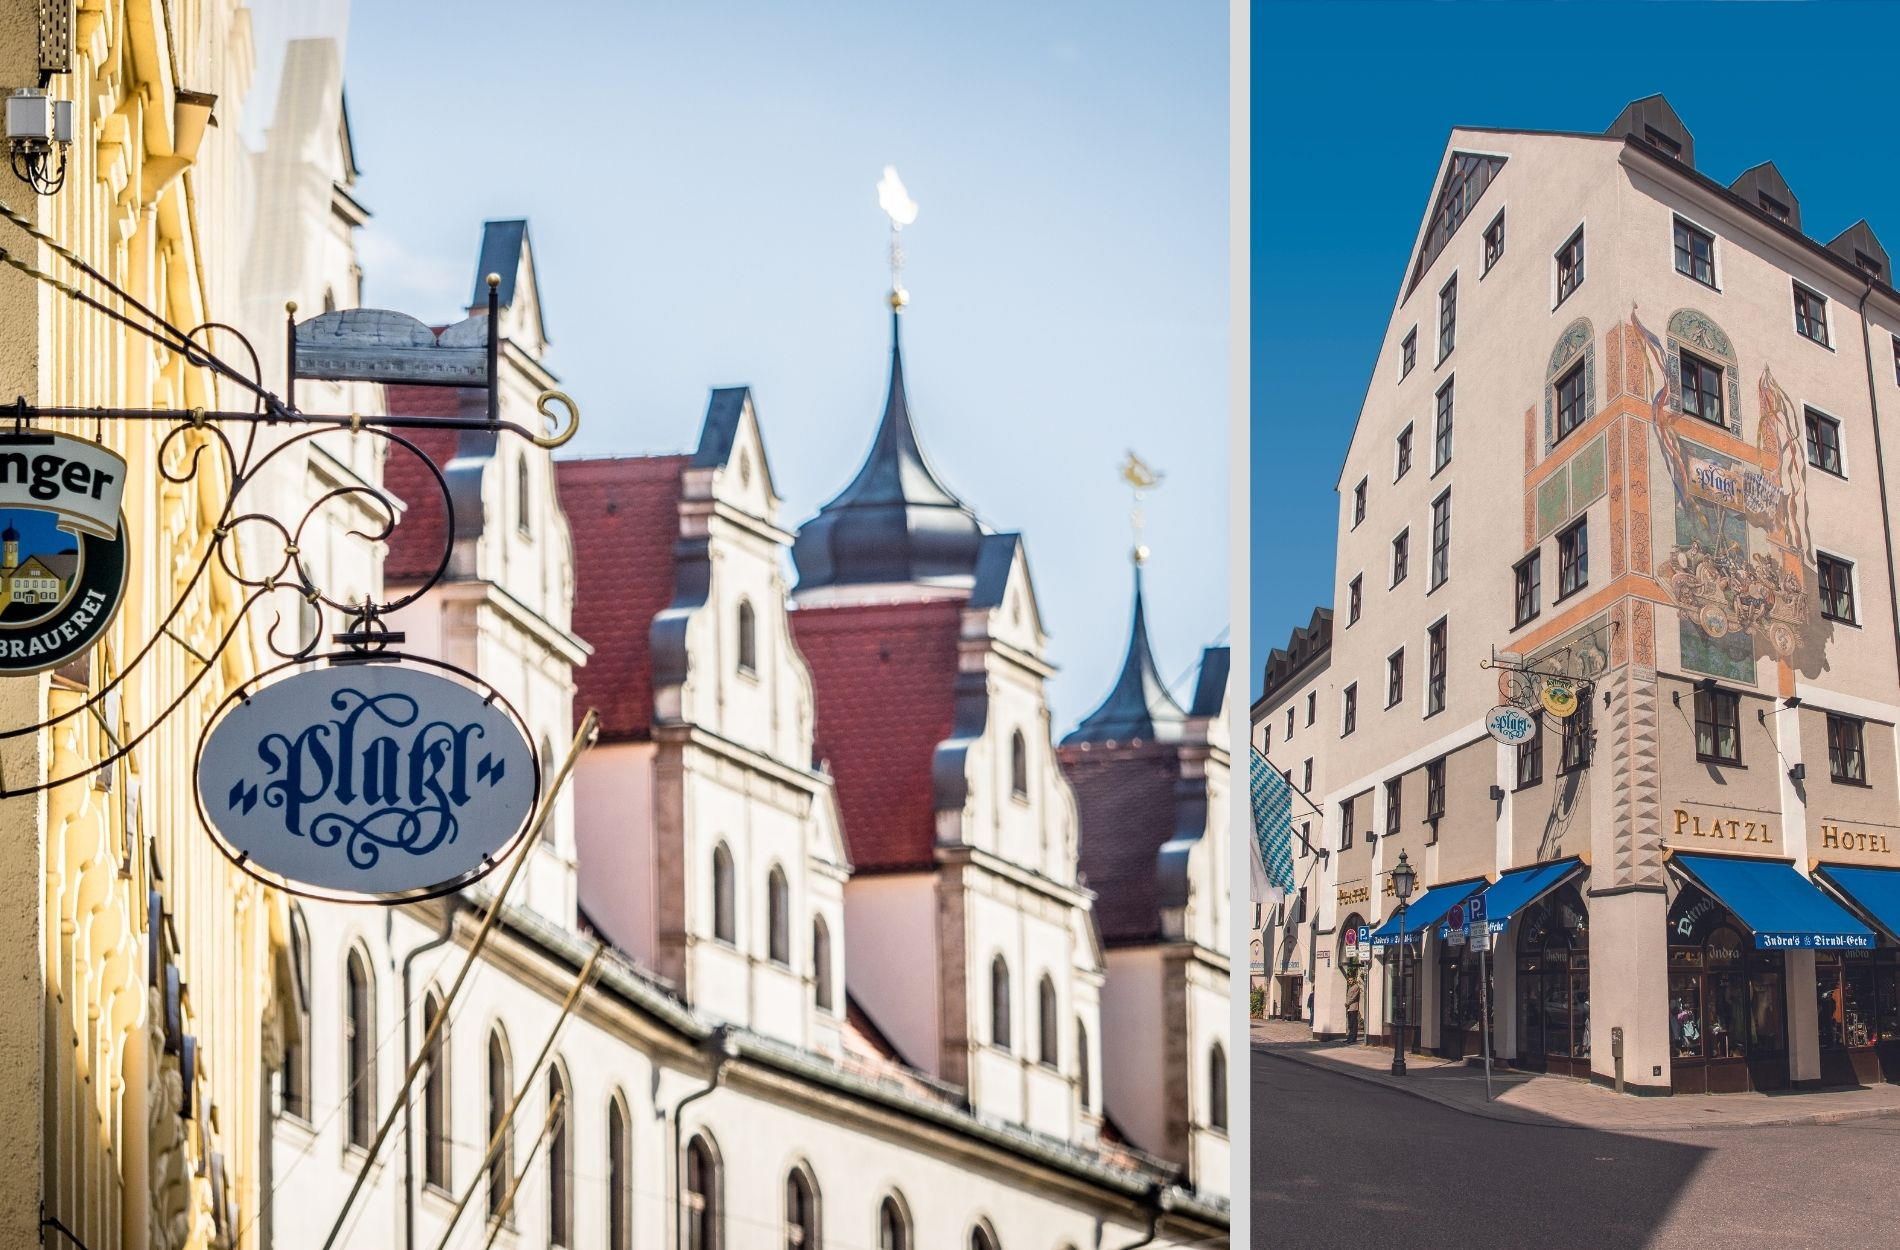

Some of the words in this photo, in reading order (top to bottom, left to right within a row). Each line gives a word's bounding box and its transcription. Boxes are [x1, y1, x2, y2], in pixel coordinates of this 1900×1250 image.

[1674, 809, 1773, 844] PLATZL
[1821, 825, 1891, 854] HOTEL
[1471, 899, 1480, 919] P
[1360, 928, 1367, 941] P
[1763, 935, 1801, 947] Indra's
[1813, 935, 1868, 947] Dirndl-Ecke
